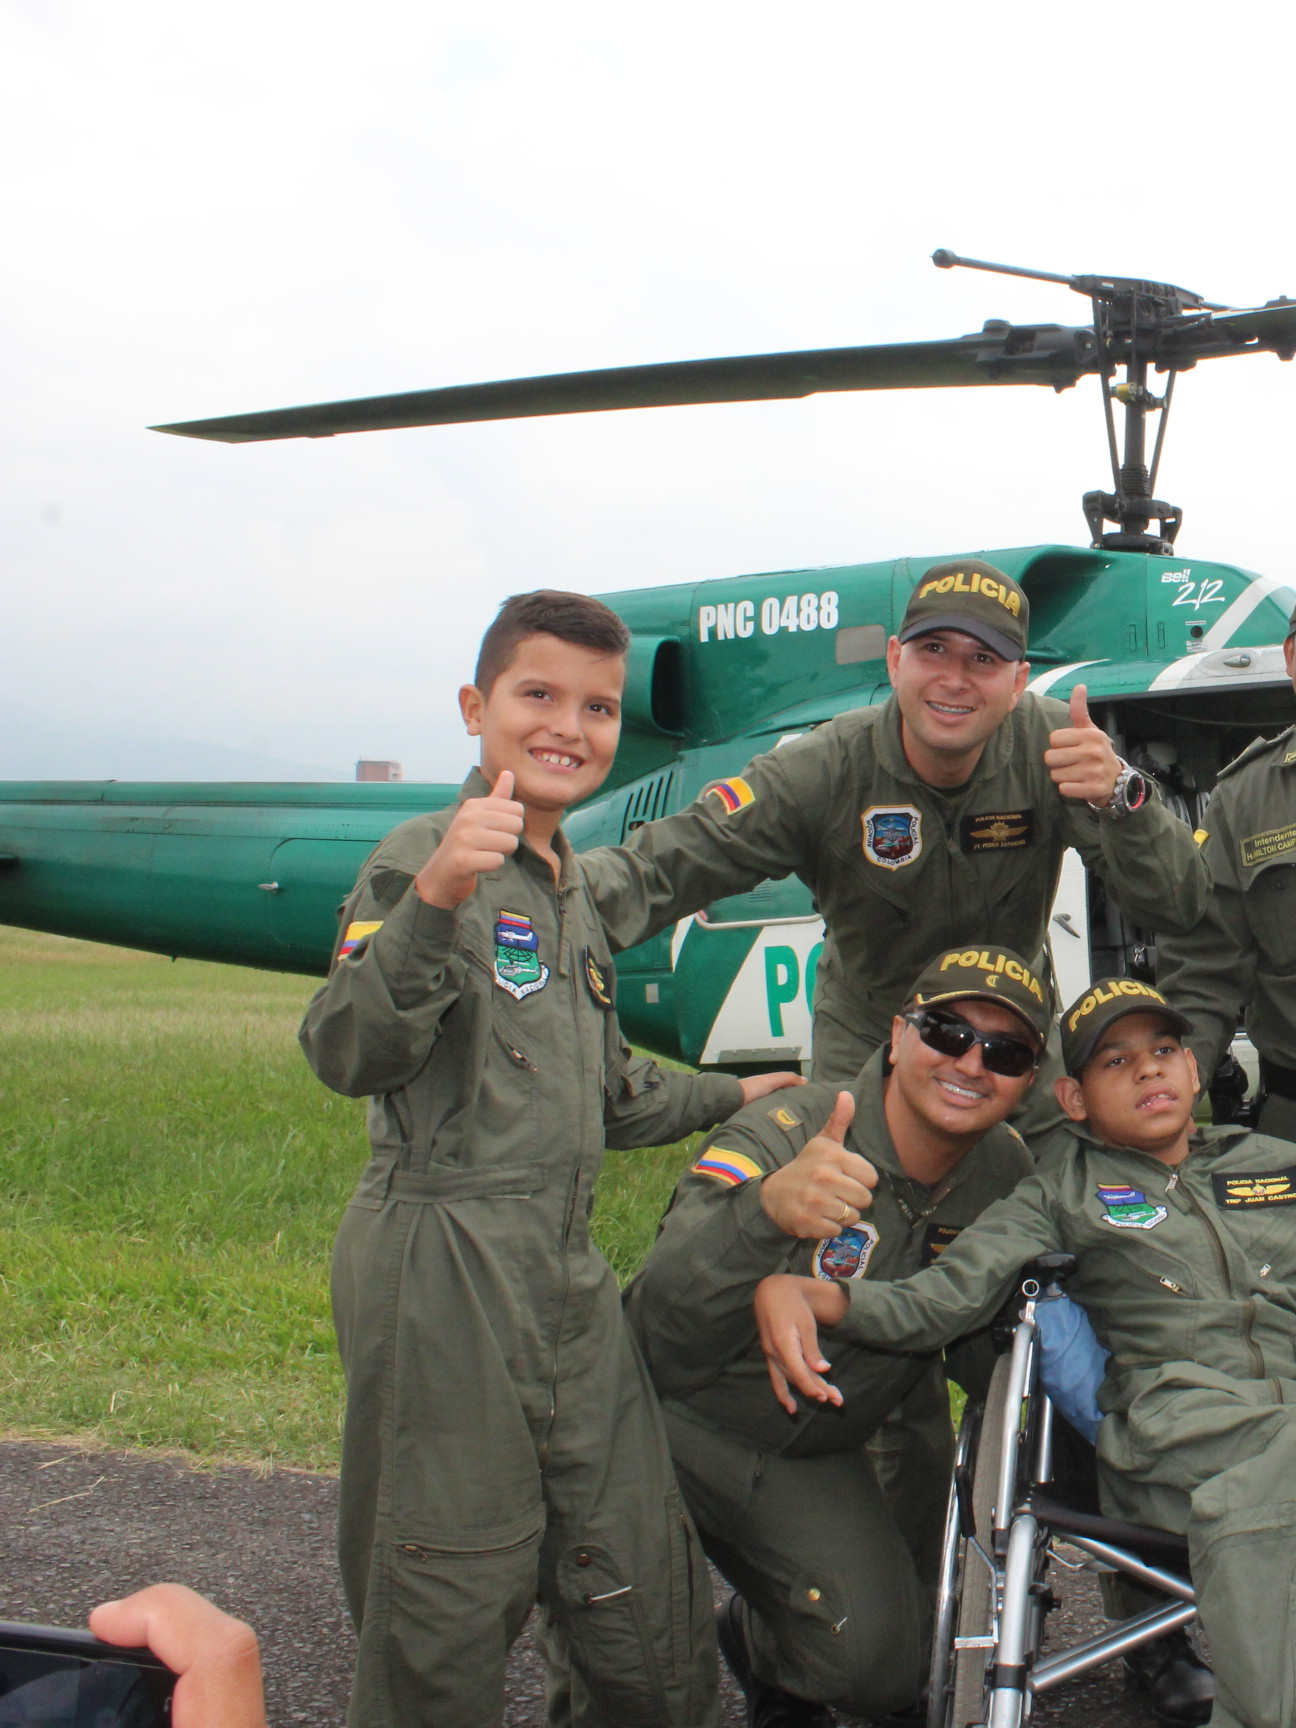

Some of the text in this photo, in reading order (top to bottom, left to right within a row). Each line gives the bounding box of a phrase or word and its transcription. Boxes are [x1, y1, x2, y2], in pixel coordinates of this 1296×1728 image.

[1161, 569, 1191, 583] Bell
[919, 573, 1020, 617] POLICIA
[1172, 578, 1225, 611] 212
[700, 591, 838, 642] PNC 0488
[1254, 830, 1296, 847] Intendente
[877, 855, 912, 865] COLOMBIA
[940, 950, 1043, 1003] POLICIA
[1069, 980, 1166, 1032] POLICIA
[859, 1239, 874, 1269] POLICIAL
